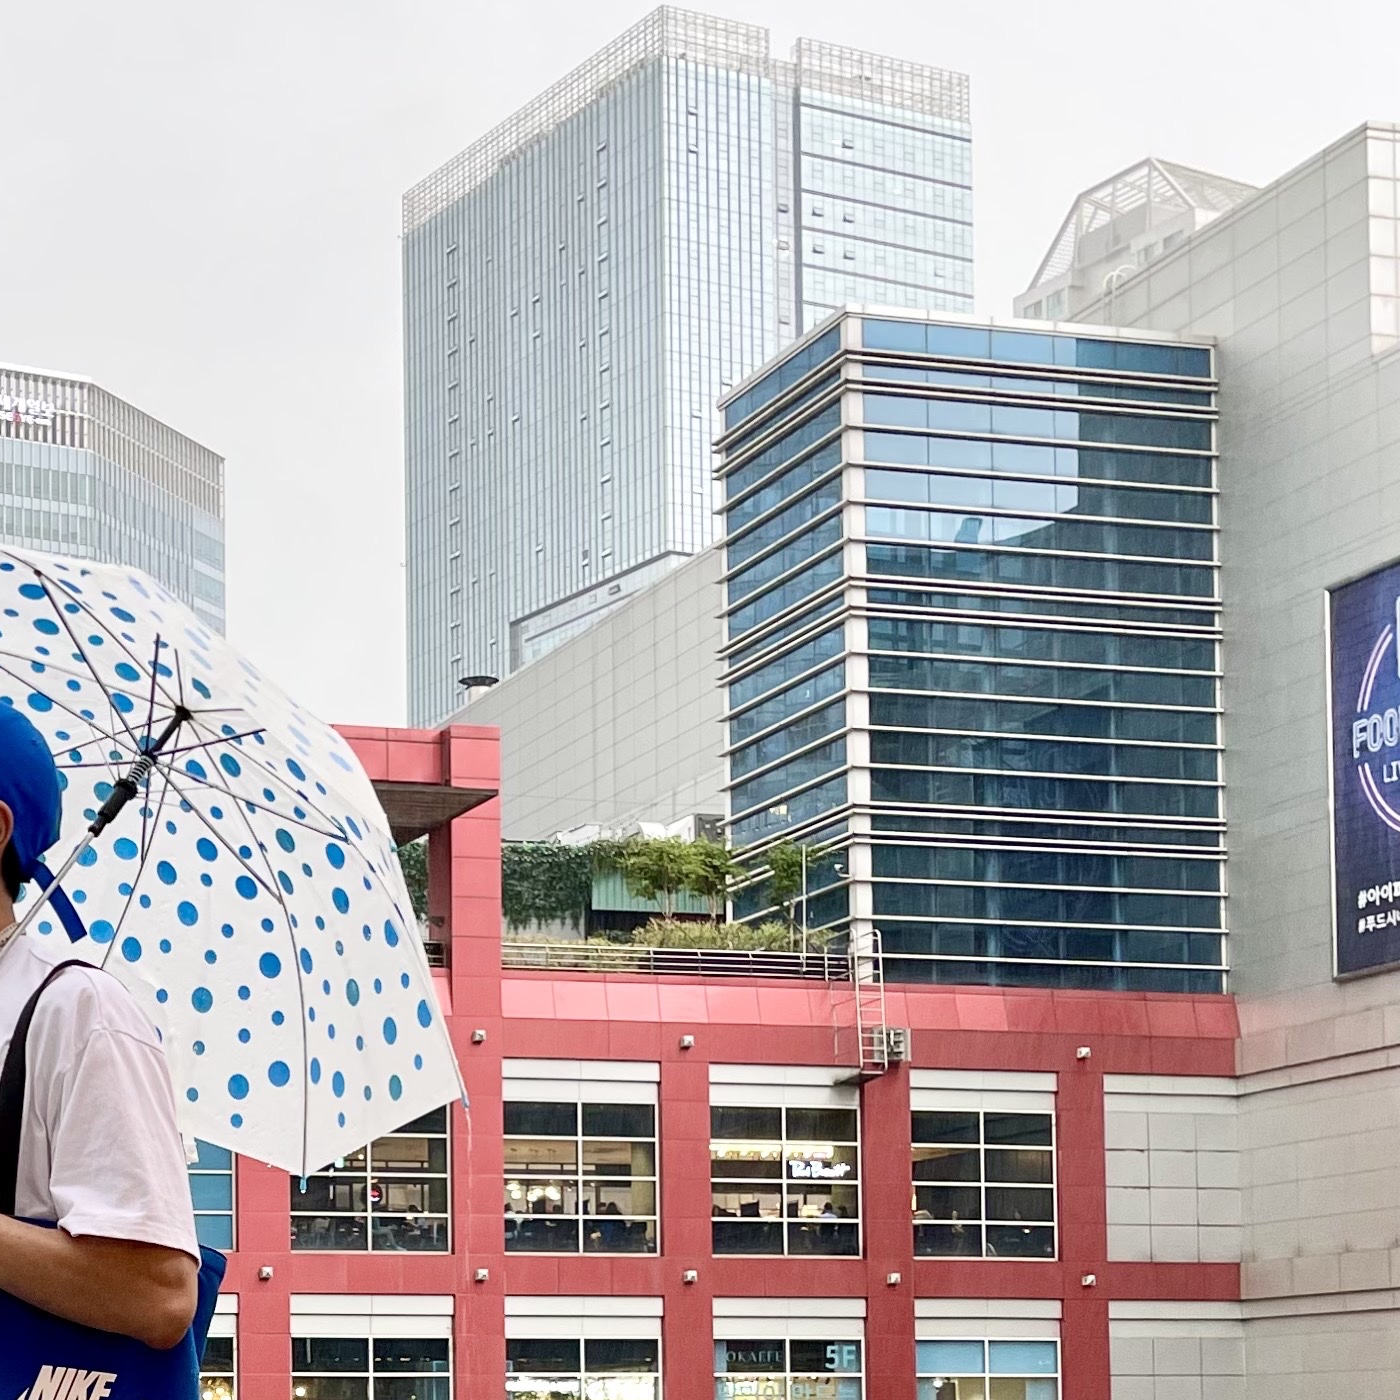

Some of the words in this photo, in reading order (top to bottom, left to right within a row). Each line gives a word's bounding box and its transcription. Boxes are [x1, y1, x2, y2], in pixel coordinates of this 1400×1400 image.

[1353, 704, 1400, 759] FOO
[1383, 761, 1400, 783] LI
[825, 1344, 857, 1369] 5F
